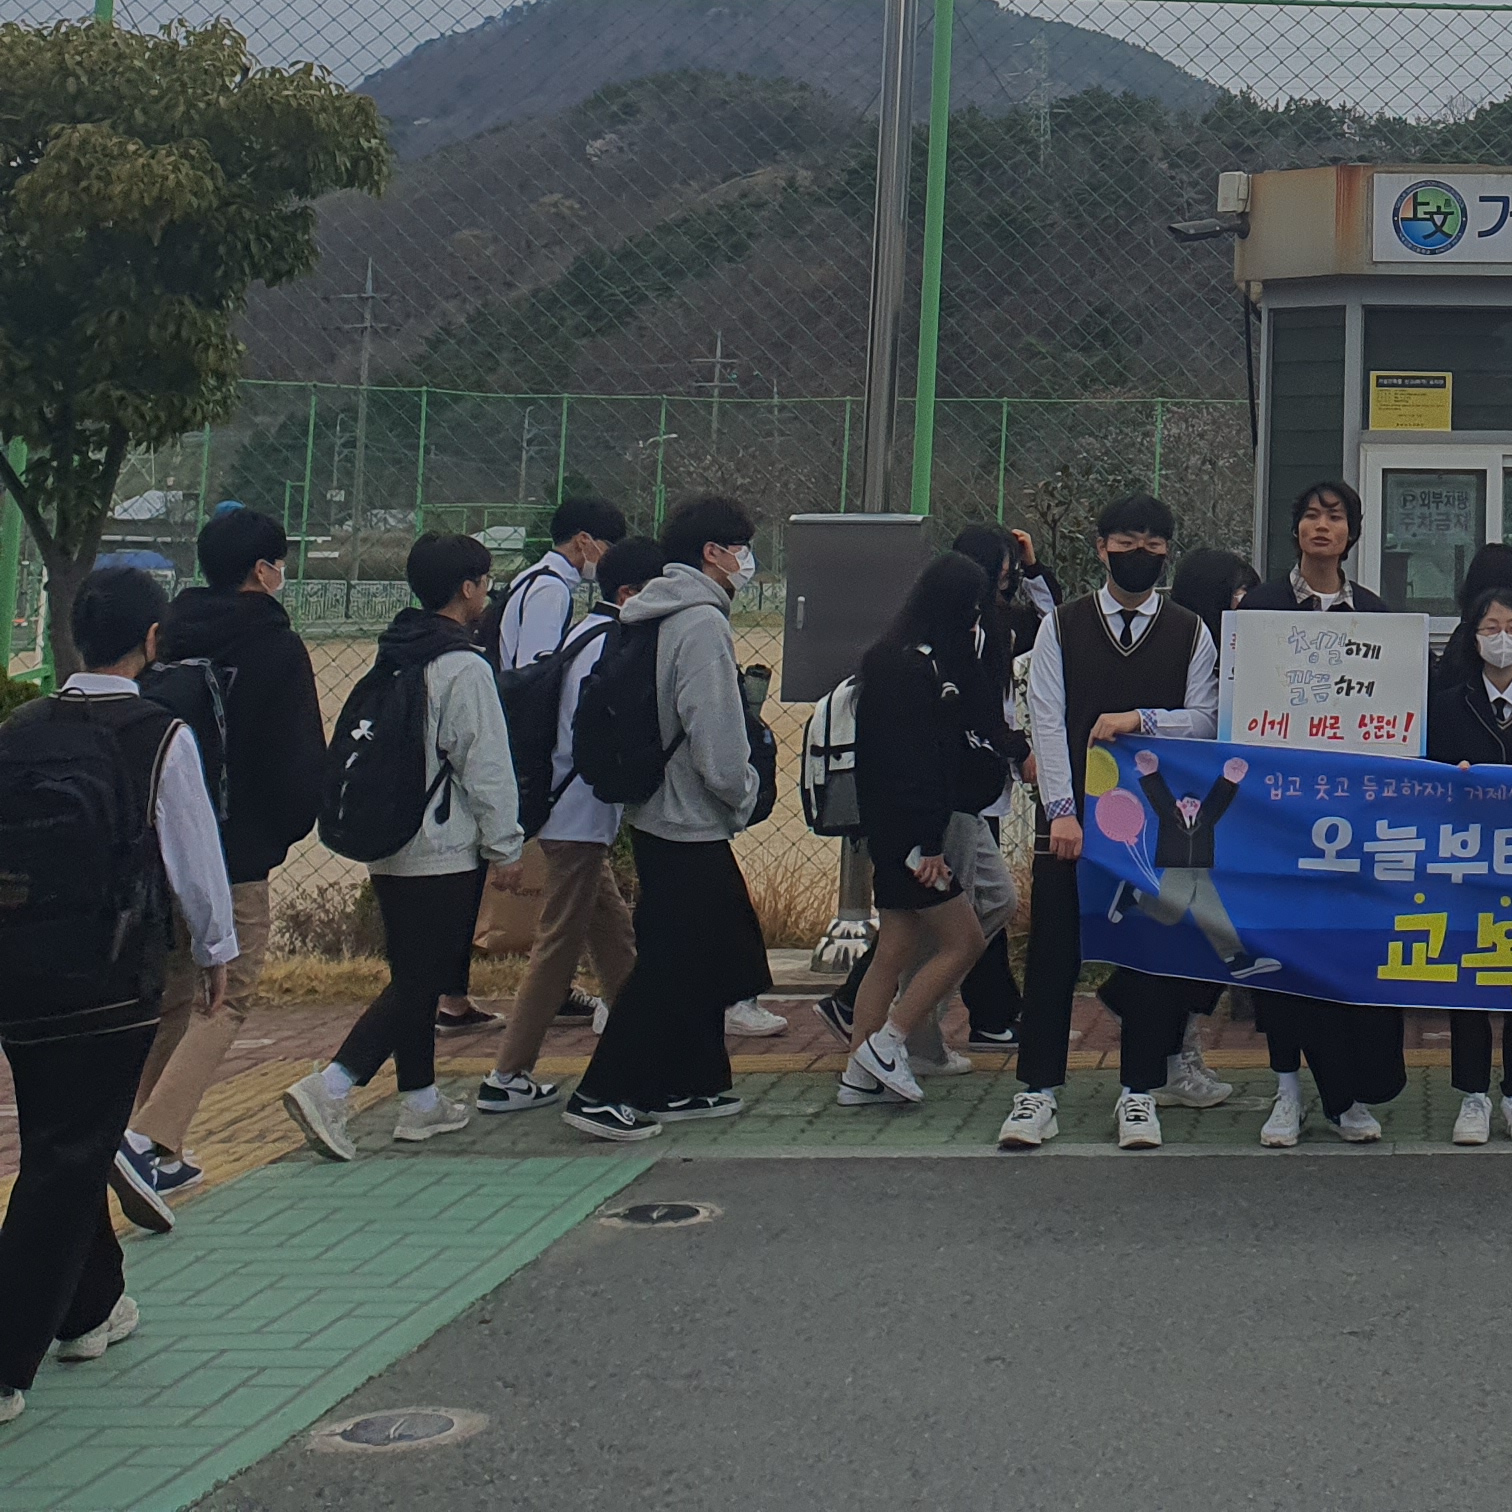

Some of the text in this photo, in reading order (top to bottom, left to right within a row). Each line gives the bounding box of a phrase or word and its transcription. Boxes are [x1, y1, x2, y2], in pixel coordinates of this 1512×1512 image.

[1287, 625, 1382, 666] 청결하게
[1285, 669, 1376, 707] 깔끔하게
[1247, 709, 1415, 744] 이게 바로 상문인!
[1265, 774, 1303, 800] 입고
[1314, 774, 1350, 800] 웃고
[1361, 775, 1454, 803] 등교하자!
